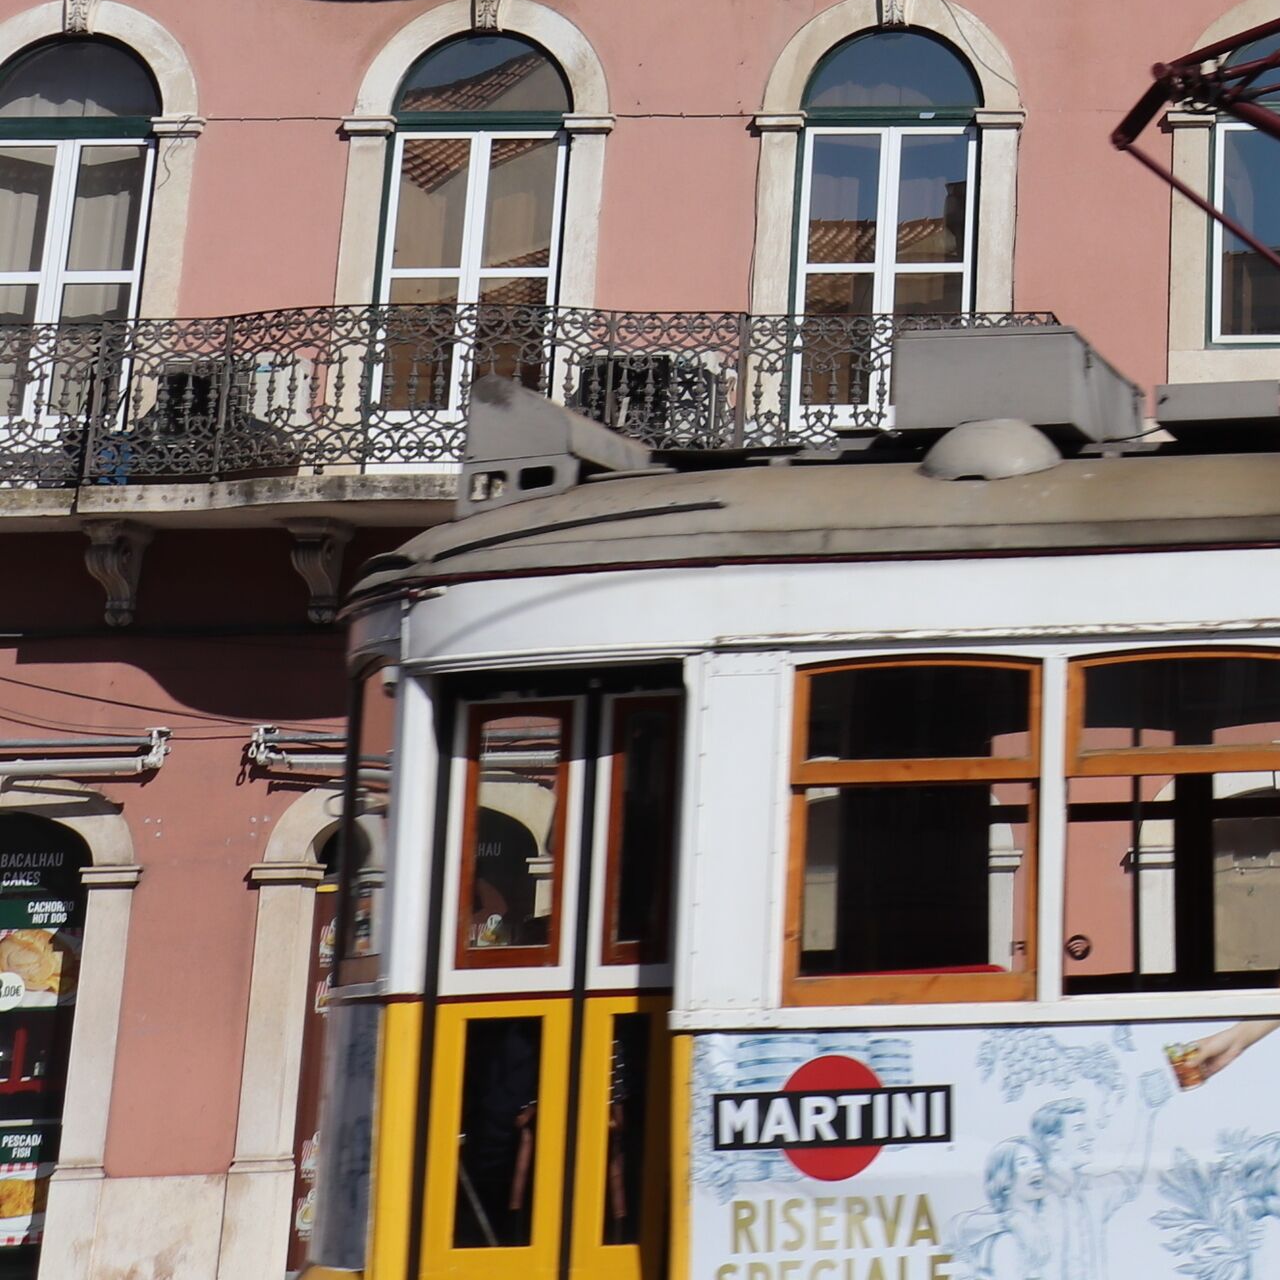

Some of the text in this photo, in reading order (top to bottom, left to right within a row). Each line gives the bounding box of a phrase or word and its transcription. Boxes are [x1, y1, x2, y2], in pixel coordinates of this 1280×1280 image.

[0, 852, 64, 868] BACALHAU
[2, 871, 41, 886] CAKES
[27, 900, 75, 914] CACHORRO
[32, 912, 68, 924] HOT DOG
[718, 1091, 947, 1145] MARTINI
[11, 1147, 32, 1158] FISH
[730, 1193, 940, 1255] RISERVA
